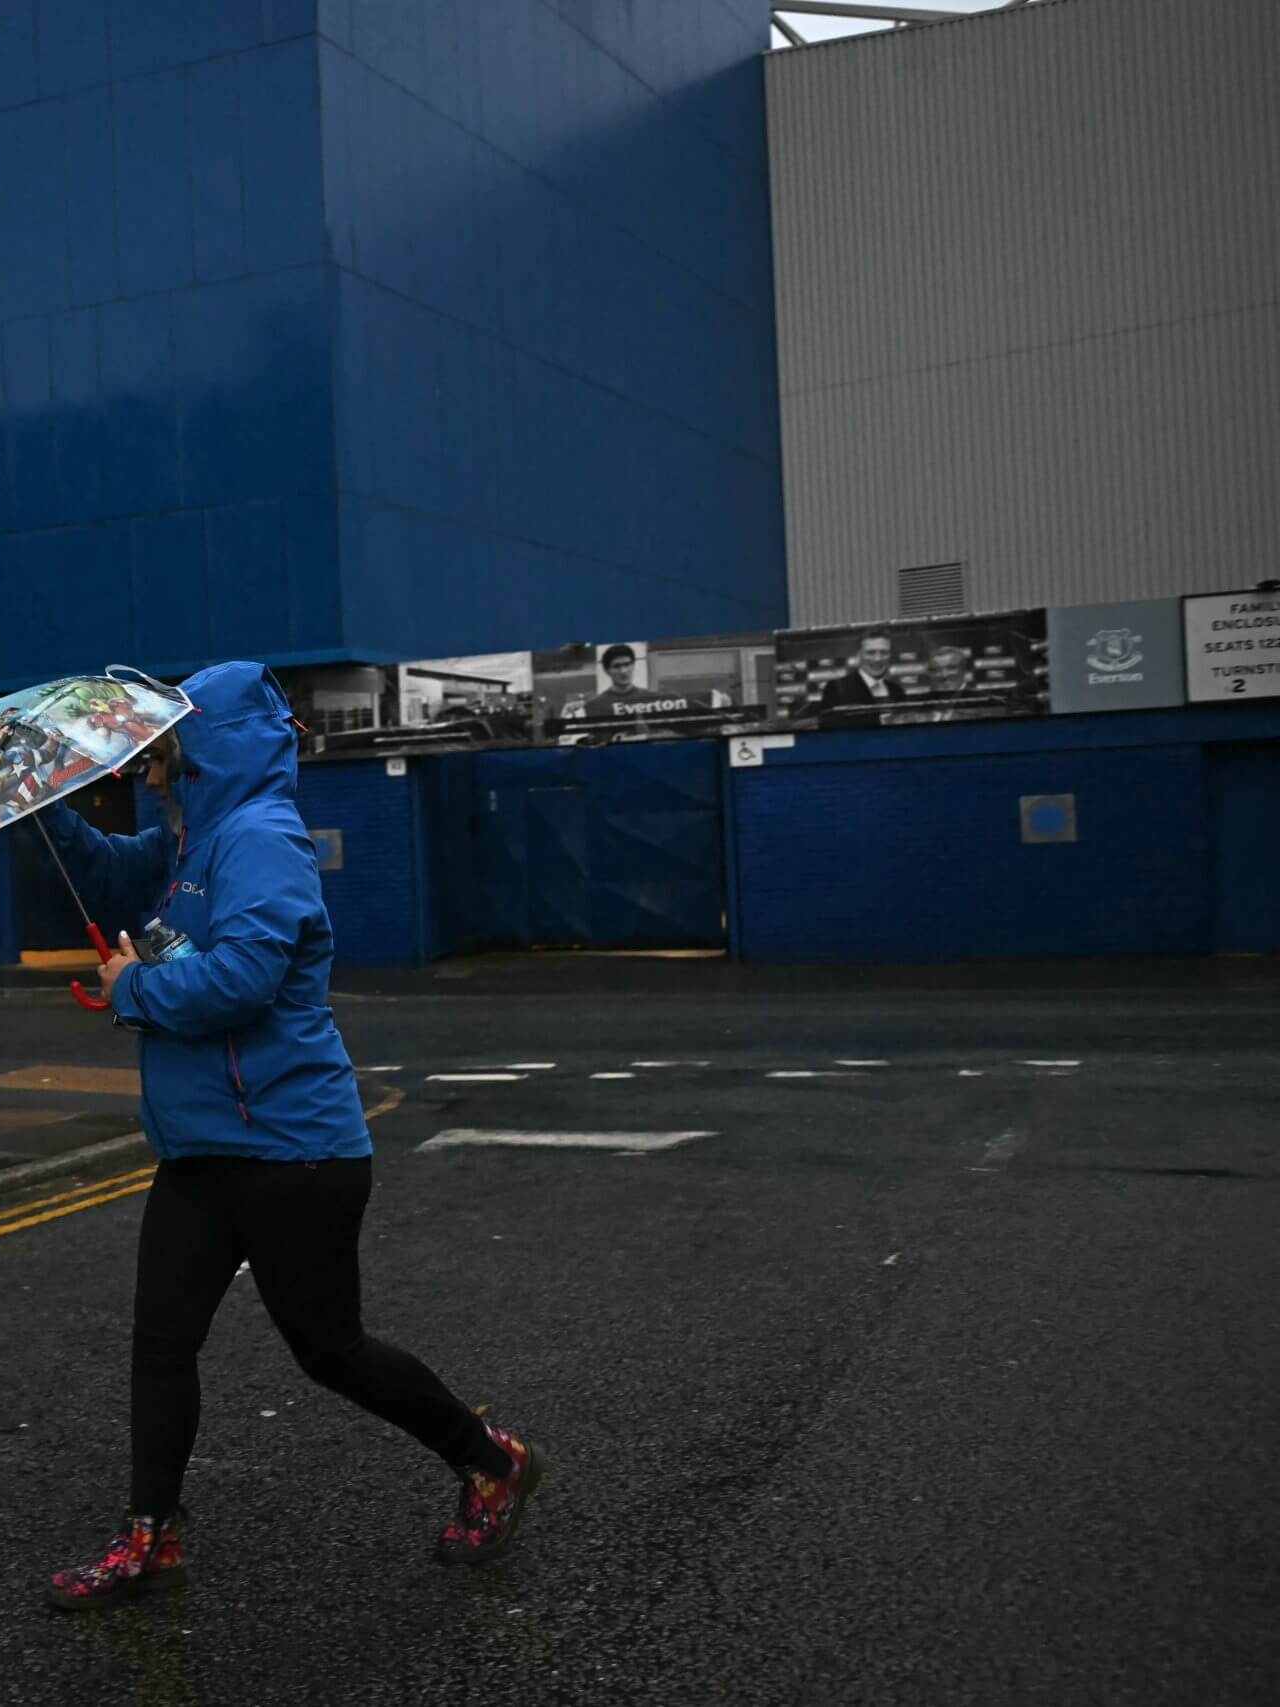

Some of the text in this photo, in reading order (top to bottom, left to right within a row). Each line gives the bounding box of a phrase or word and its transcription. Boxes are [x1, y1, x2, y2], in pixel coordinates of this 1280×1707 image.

[1204, 640, 1255, 653] SEATS
[1232, 679, 1246, 693] 2
[612, 697, 688, 717] Everton
